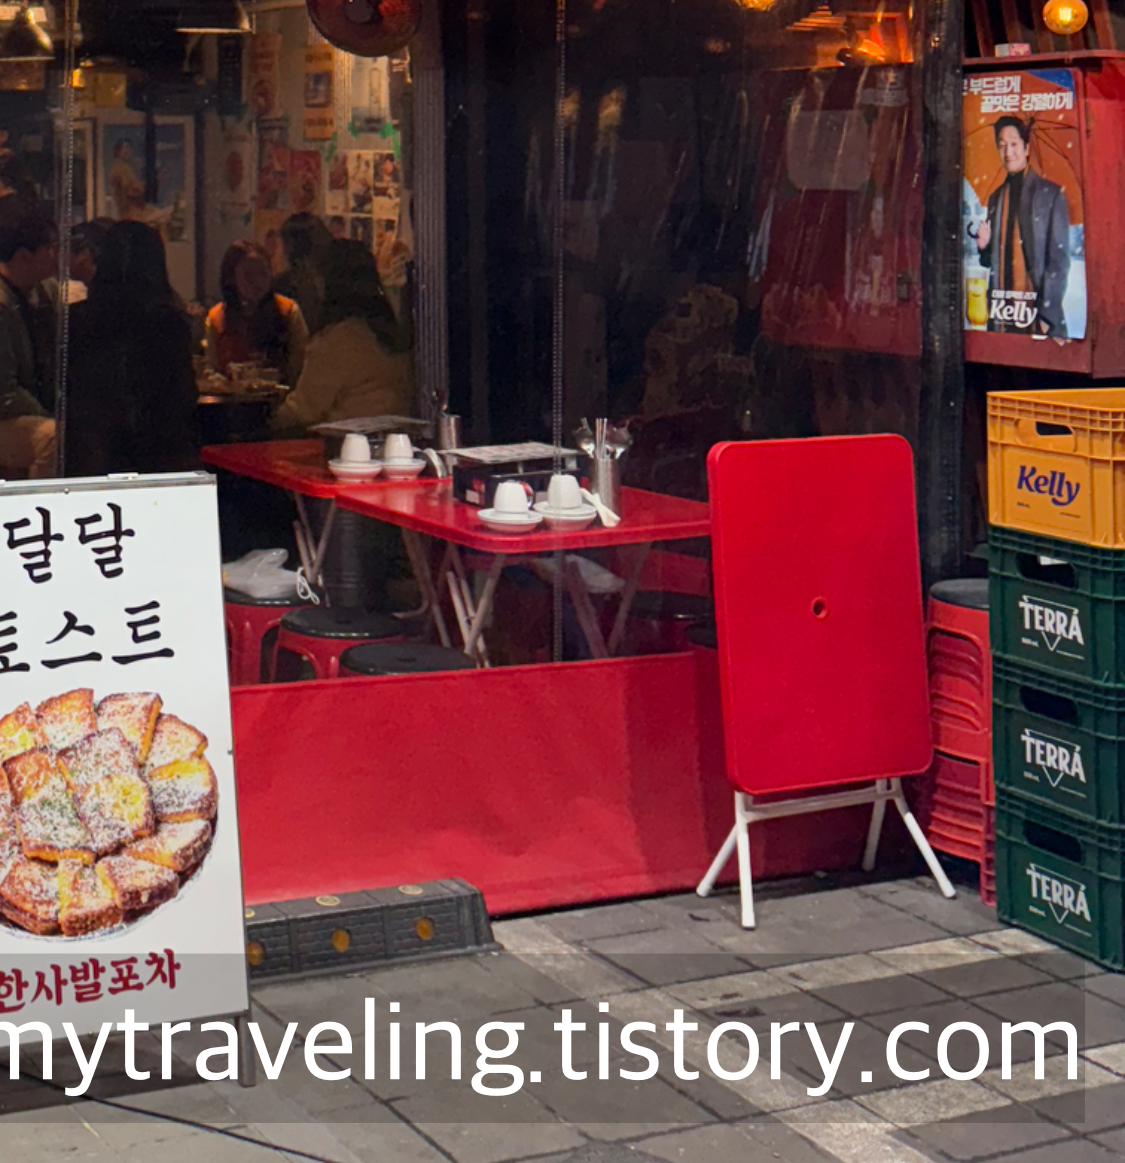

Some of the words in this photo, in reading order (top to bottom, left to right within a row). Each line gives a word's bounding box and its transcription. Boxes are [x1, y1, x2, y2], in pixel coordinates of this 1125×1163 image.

[969, 76, 1021, 95] 부드럽게
[989, 299, 1038, 328] Kelly
[1016, 464, 1081, 507] Kelly
[3, 502, 135, 584] 달달
[1018, 601, 1085, 645] TERRA
[1020, 734, 1087, 783] TERRA
[1026, 868, 1091, 922] TERRA
